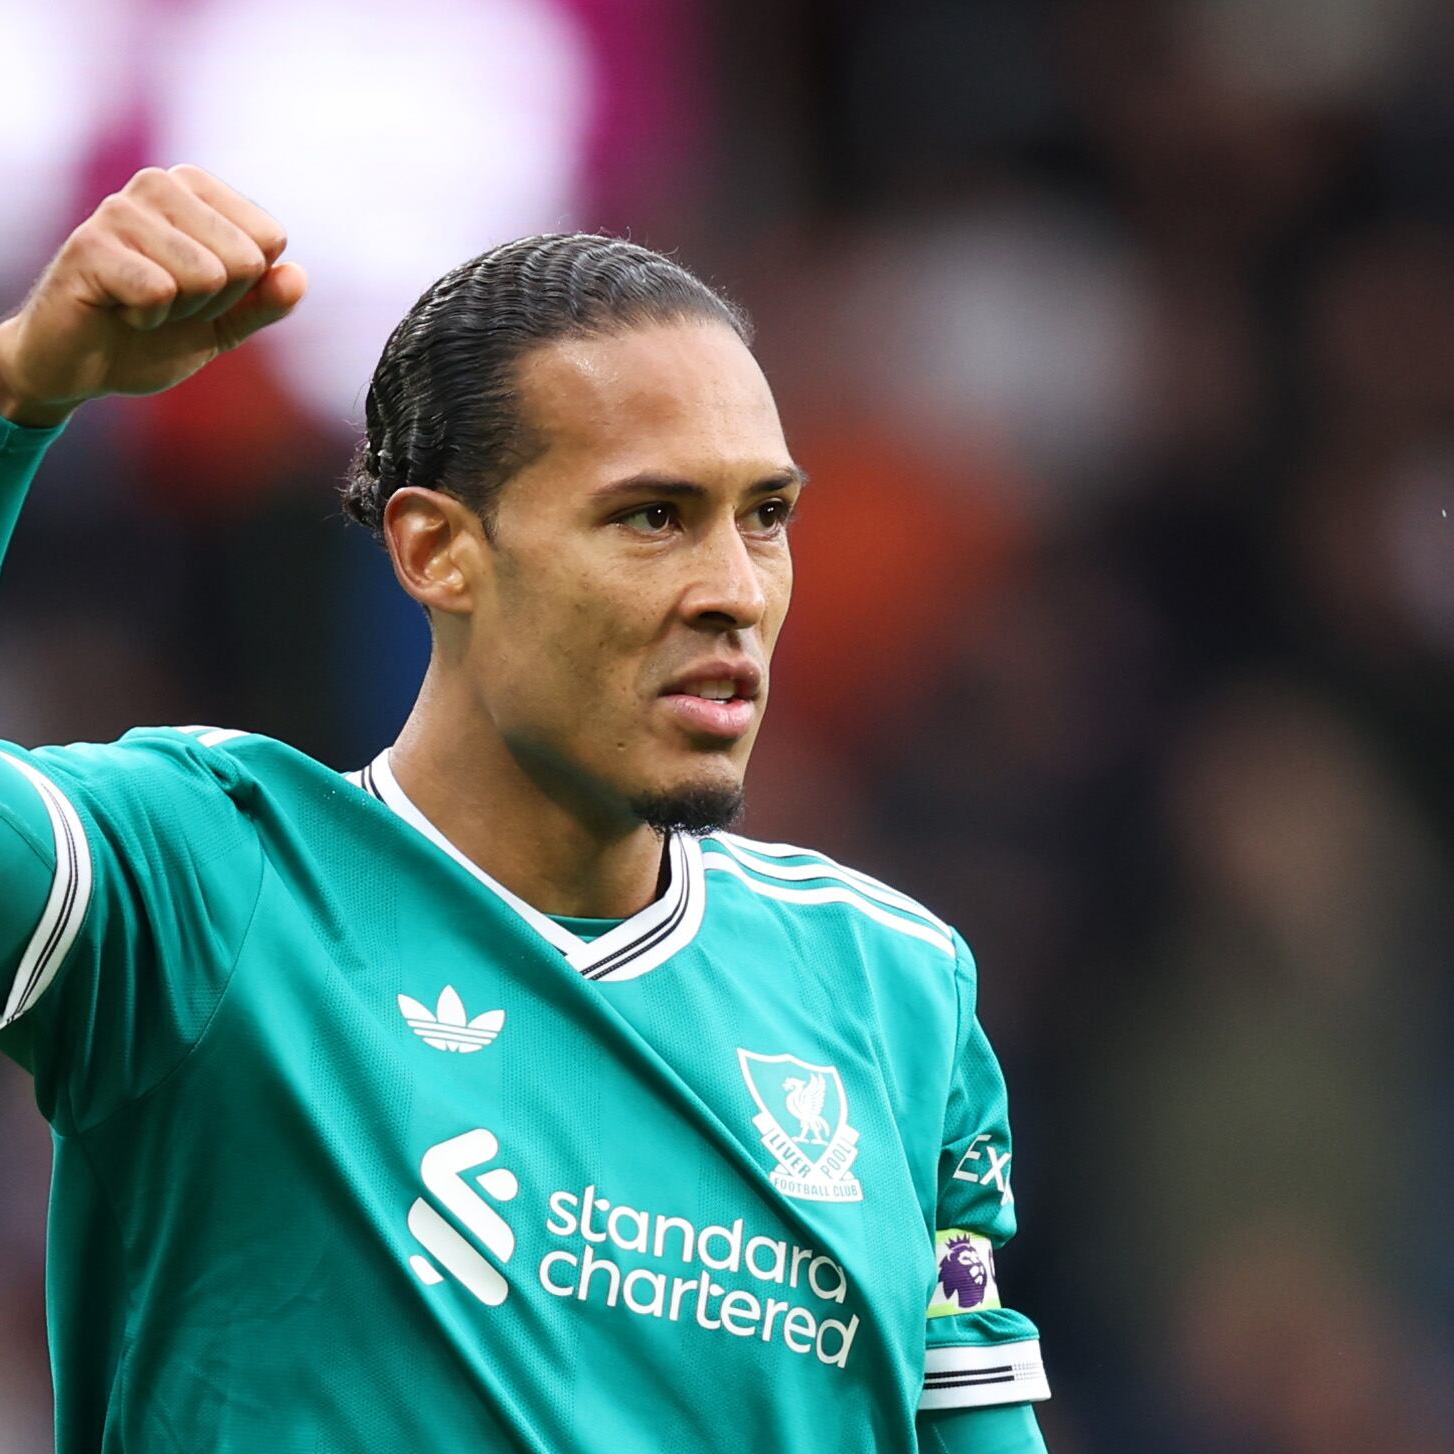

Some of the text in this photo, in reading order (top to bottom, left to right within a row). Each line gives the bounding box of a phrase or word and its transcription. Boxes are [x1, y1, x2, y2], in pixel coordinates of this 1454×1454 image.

[768, 1133, 852, 1180] LIVER POOL
[774, 1176, 858, 1197] FOOTBALL CLUB
[539, 1243, 860, 1369] chartered
